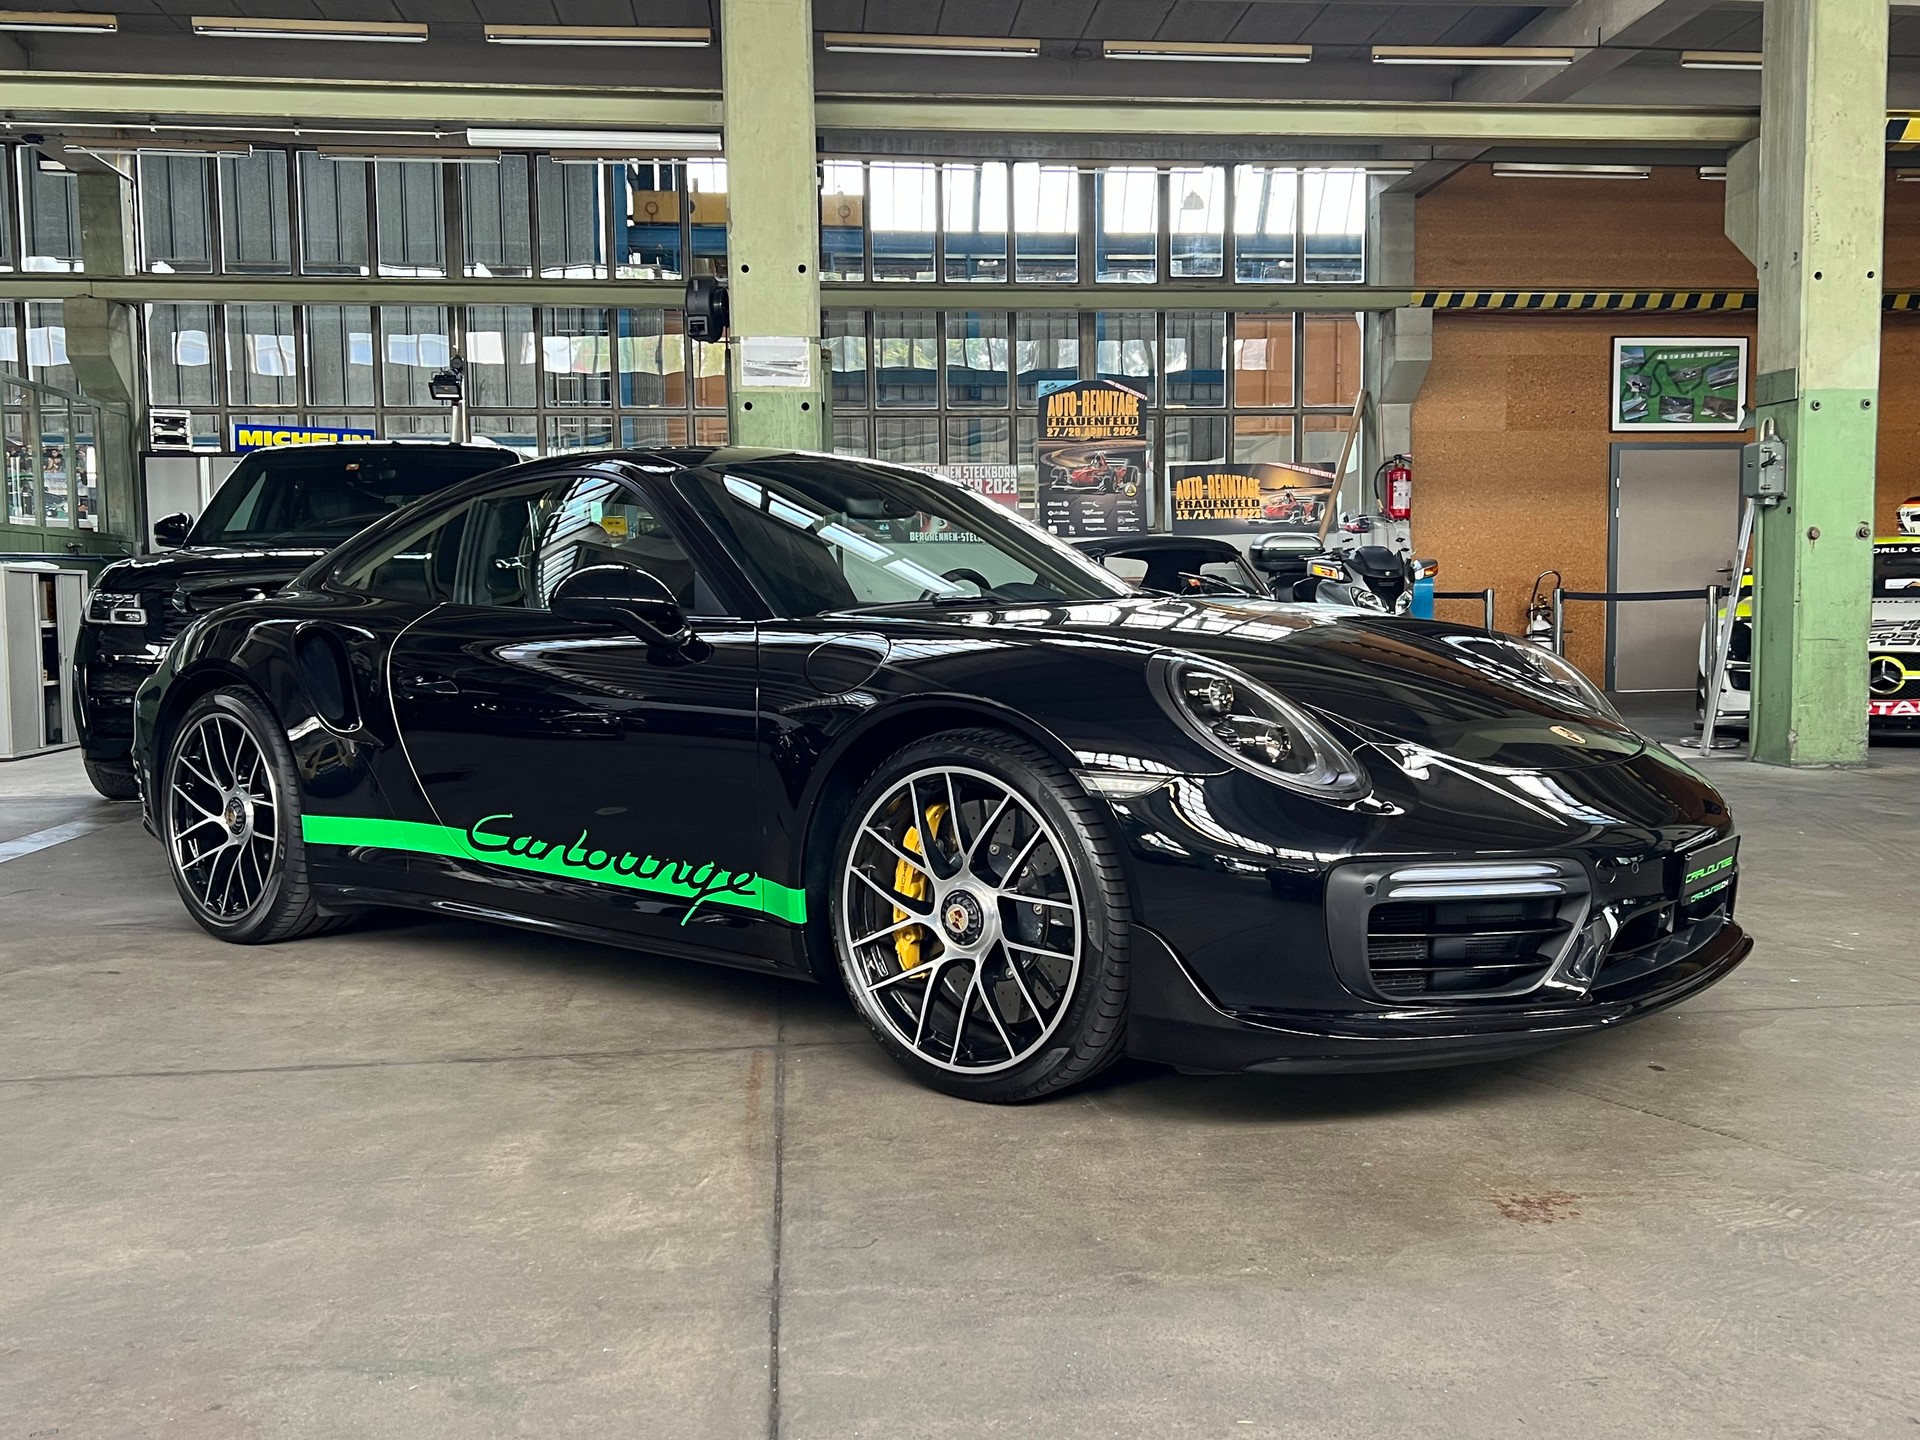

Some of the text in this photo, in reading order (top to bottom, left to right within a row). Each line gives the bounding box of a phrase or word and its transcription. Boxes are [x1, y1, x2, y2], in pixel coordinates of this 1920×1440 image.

[1047, 390, 1139, 417] AUTO-RENNTAGE
[1047, 417, 1138, 427] FRAUENFELD
[1113, 427, 1138, 436] 2024
[963, 465, 1017, 478] STECKBORN
[986, 479, 1018, 494] 2023
[1176, 474, 1261, 500] AUTO-RENNTAGE
[1177, 500, 1260, 508] FRAUENFELD
[1235, 508, 1261, 519] 2023
[1685, 856, 1733, 884] CARLOUNGE
